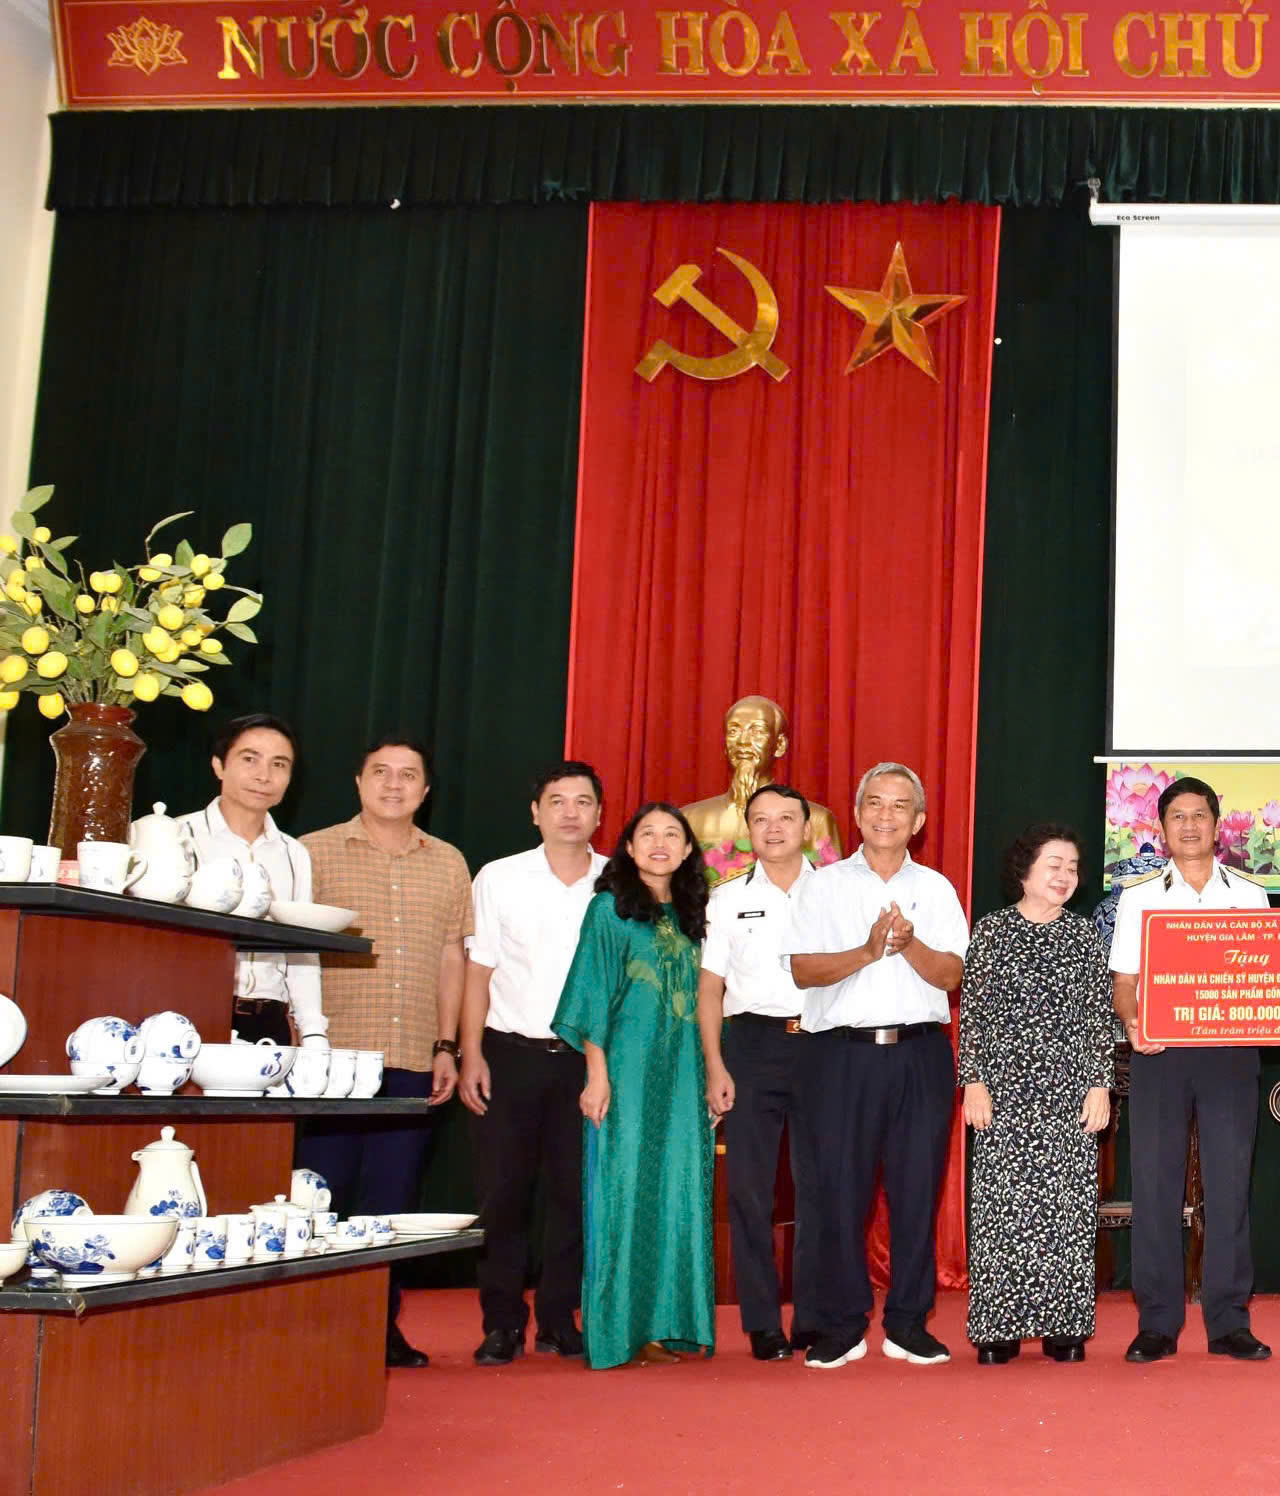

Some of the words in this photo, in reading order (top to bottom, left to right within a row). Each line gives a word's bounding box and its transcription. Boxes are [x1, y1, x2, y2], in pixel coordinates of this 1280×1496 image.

[216, 0, 417, 80] NƯỚC
[438, 0, 632, 93] CỘNG
[960, 0, 1088, 95] HỘI
[1113, 0, 1269, 79] CHỦ
[1219, 933, 1234, 941] GIA
[1224, 949, 1270, 967] Tặng
[1153, 972, 1176, 985] NHÂN
[1178, 972, 1195, 985] DÂN
[1248, 971, 1275, 985] HUYỆN
[1195, 989, 1219, 1000] 15000
[1221, 986, 1238, 999] SẢN
[1174, 1006, 1195, 1024] TRỊ
[1198, 1004, 1226, 1021] GIÁ:
